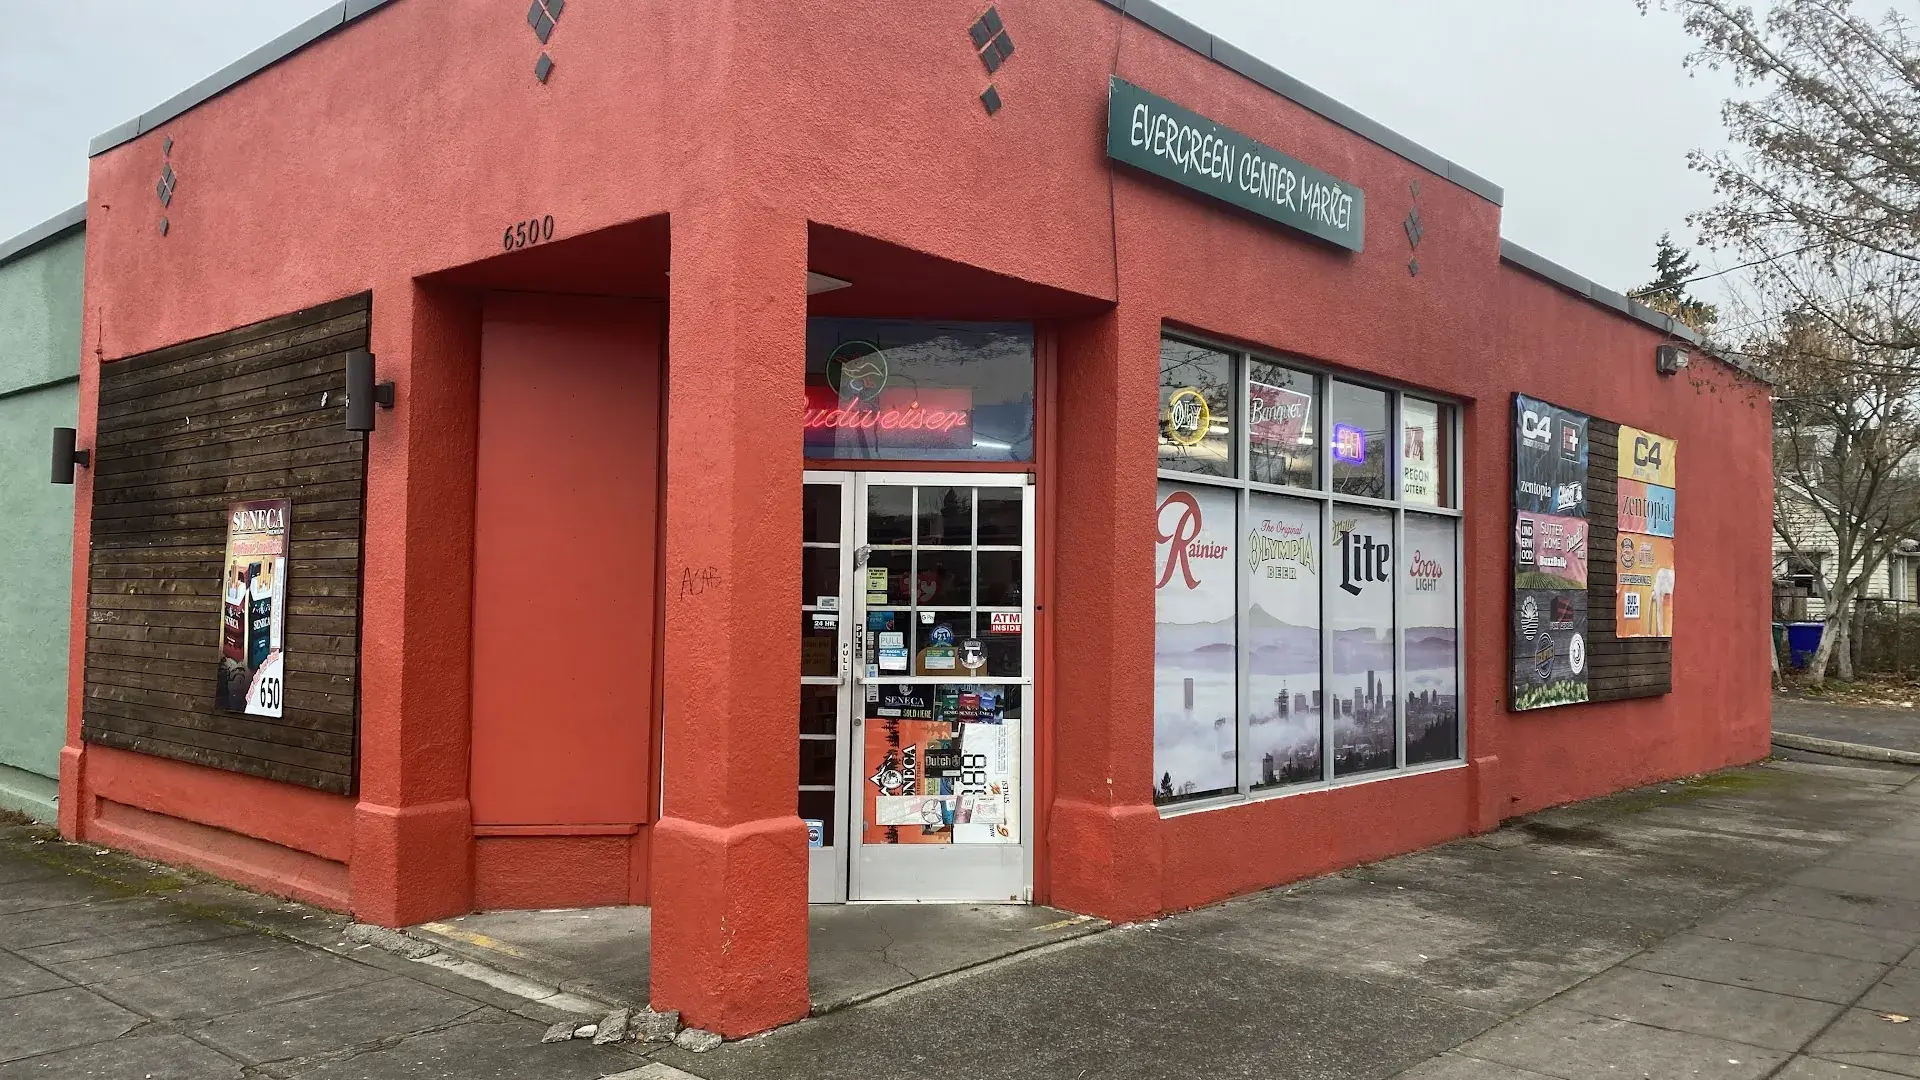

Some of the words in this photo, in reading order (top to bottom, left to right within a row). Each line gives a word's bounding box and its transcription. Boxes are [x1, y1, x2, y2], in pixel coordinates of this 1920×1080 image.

[1131, 103, 1235, 184] EVERGREEN
[1239, 153, 1296, 212] CENTER
[1300, 175, 1353, 232] MARKET
[504, 214, 554, 251] 6500
[803, 396, 967, 433] udweiser
[1172, 400, 1202, 430] OLY
[1249, 397, 1302, 424] Banquet
[1522, 410, 1552, 443] C4
[1633, 436, 1662, 470] C4
[1404, 467, 1430, 482] REGON
[1403, 483, 1427, 496] OTTERY
[1521, 480, 1552, 502] zentopia
[232, 508, 285, 532] SENECA
[1623, 495, 1671, 529] zentopia
[1260, 519, 1275, 533] The
[1276, 520, 1304, 539] Original
[1332, 519, 1358, 545] Miller
[1521, 526, 1533, 537] UND
[1540, 521, 1564, 536] SUTTER
[1155, 490, 1228, 590] Rainier
[1521, 538, 1533, 548] ERW
[1543, 537, 1562, 550] HOME
[1249, 527, 1316, 575] OLYMPIA
[1521, 550, 1533, 560] OOD
[1266, 565, 1297, 580] BEER
[1339, 530, 1390, 596] Lite
[1409, 549, 1443, 578] Coors
[1415, 578, 1438, 592] LIGHT
[1627, 595, 1637, 604] BUD
[993, 613, 1020, 623] ATM
[880, 636, 902, 645] PULL
[937, 633, 947, 641] 21
[260, 677, 280, 710] 650
[884, 696, 925, 706] SENECA
[902, 709, 916, 718] SOLD
[917, 709, 932, 719] HERE
[902, 743, 917, 796] NECA
[925, 755, 951, 767] Dutch
[1001, 780, 1010, 804] STYLES!
[996, 824, 1009, 837] 6
